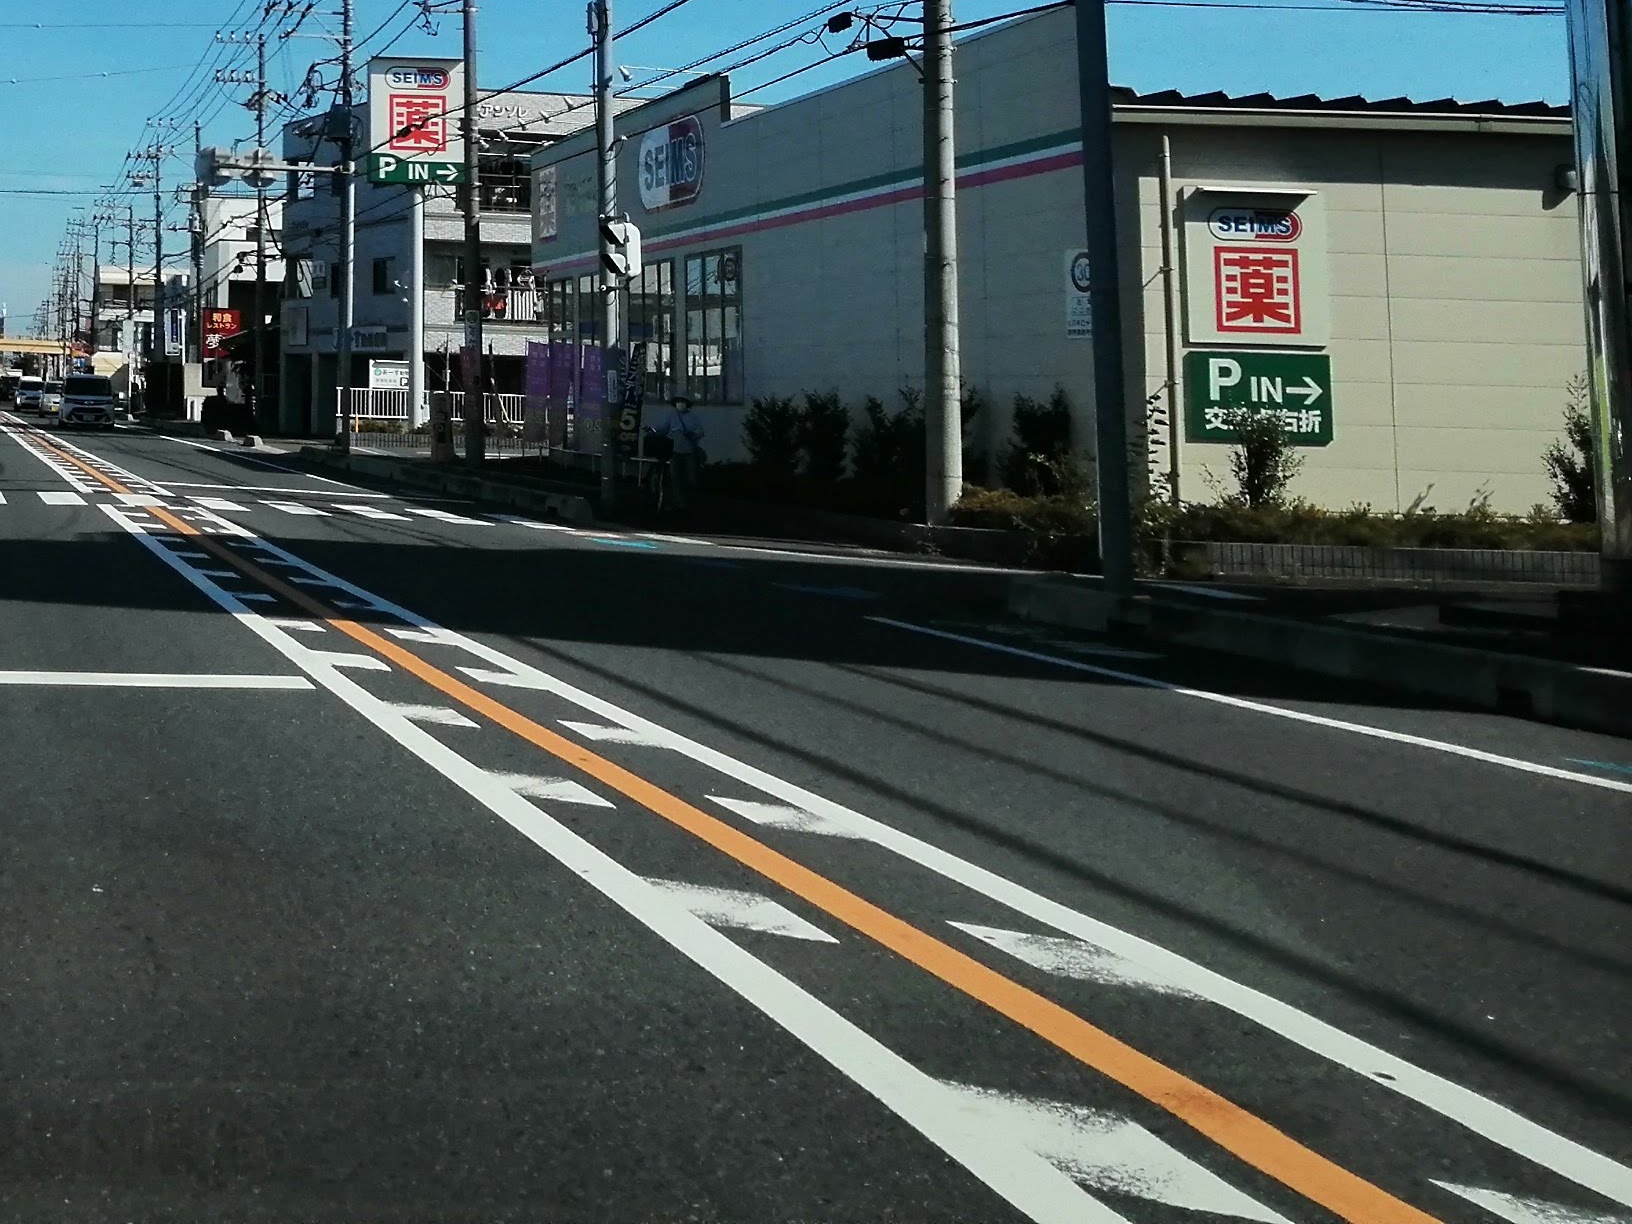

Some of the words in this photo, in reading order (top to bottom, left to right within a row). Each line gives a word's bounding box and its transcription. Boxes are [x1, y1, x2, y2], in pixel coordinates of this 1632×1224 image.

[392, 72, 444, 86] SEIMS
[394, 98, 443, 148] 薬
[379, 156, 397, 179] P
[408, 163, 430, 180] IN
[644, 131, 698, 191] SEIMS
[1217, 215, 1293, 235] SEIMS
[1223, 255, 1292, 323] 薬
[206, 322, 238, 330] レストラン
[212, 312, 233, 323] 和食
[206, 333, 228, 350] 夢
[1208, 357, 1243, 402] P
[1250, 376, 1284, 404] IN
[1204, 406, 1322, 433] 交右折
